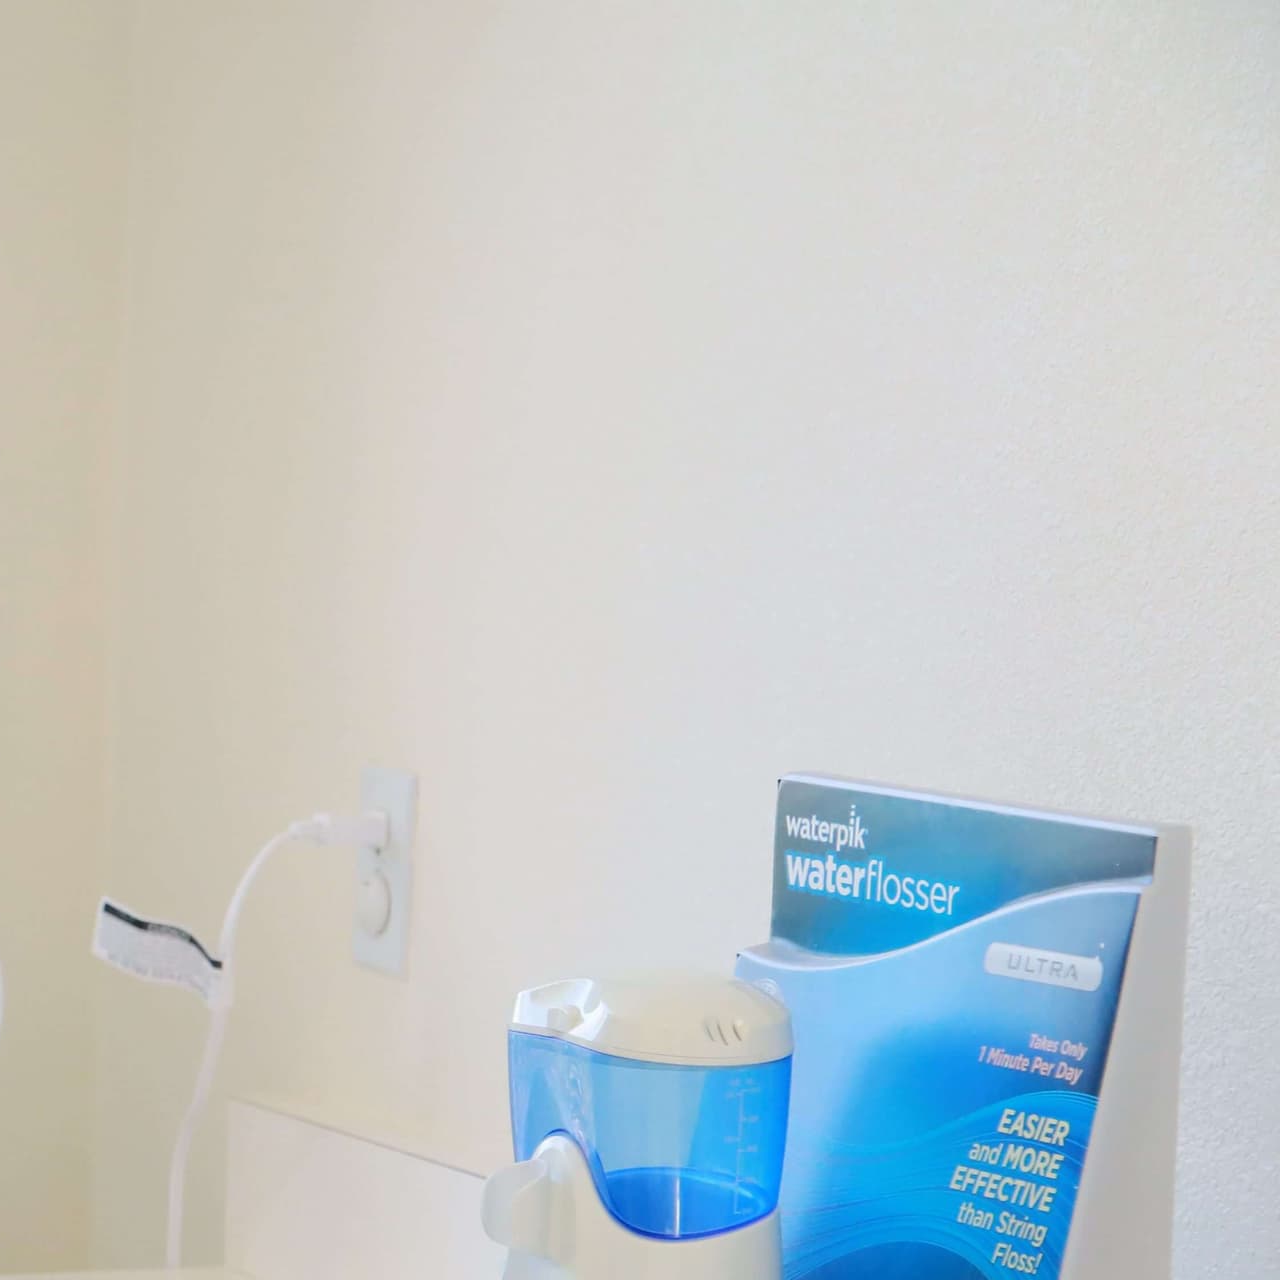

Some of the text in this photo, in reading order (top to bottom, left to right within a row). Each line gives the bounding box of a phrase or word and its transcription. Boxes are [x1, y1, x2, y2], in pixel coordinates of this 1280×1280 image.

[786, 805, 866, 851] waterpik
[786, 854, 961, 916] waterflosser
[1007, 952, 1079, 981] ULTRA
[978, 1045, 1084, 1086] 1 Minute Per Day
[1029, 1033, 1088, 1061] Takes Only
[997, 1108, 1070, 1147] EASIER
[969, 1142, 1065, 1180] and MORE
[949, 1165, 1057, 1212] EFFECTIVE
[957, 1202, 1048, 1248] than String
[991, 1242, 1043, 1275] Floss!
